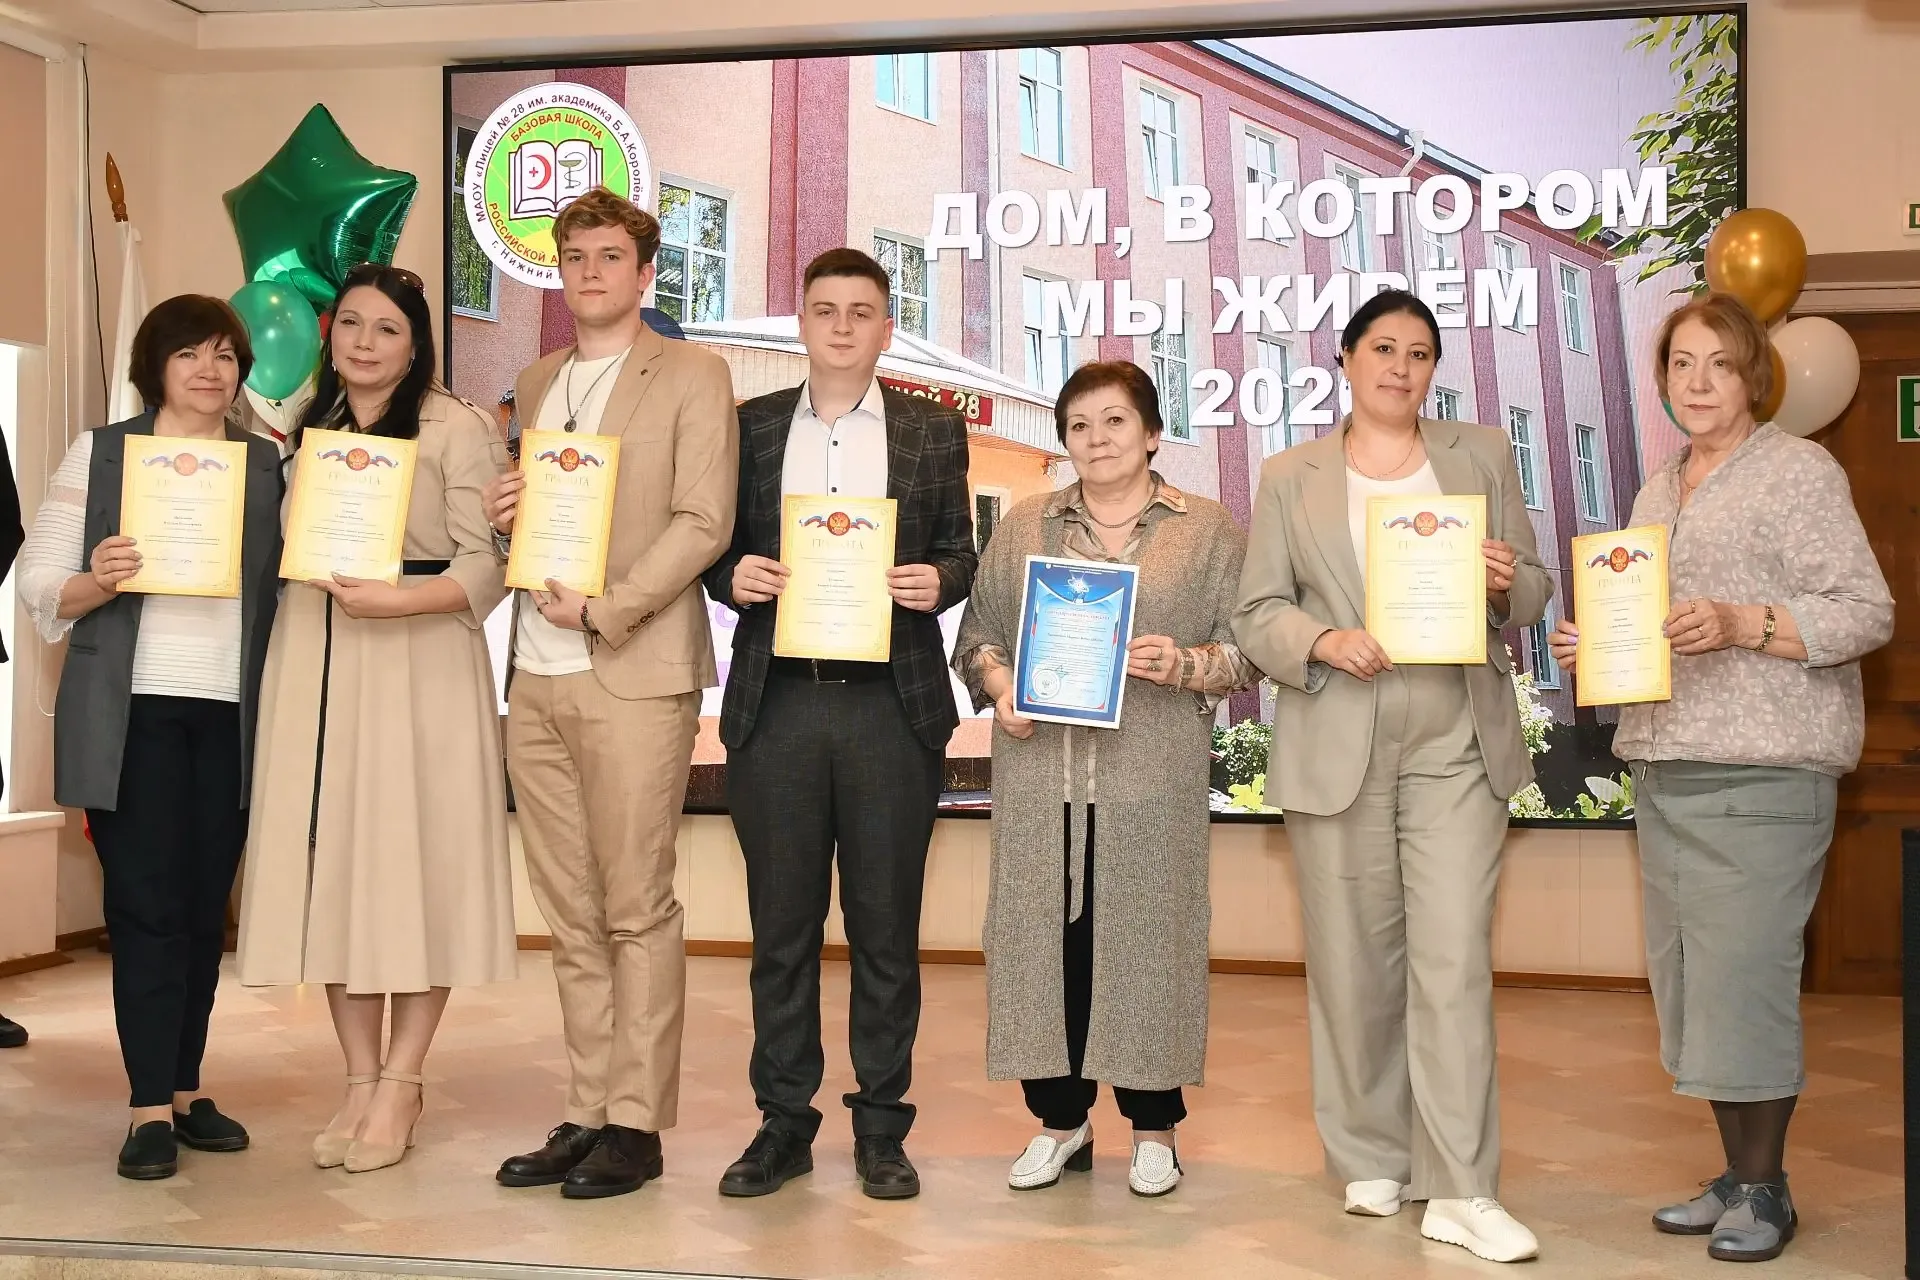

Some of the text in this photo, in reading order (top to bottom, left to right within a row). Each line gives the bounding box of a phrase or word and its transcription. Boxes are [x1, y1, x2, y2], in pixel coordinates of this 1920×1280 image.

[511, 103, 525, 118] 28
[527, 97, 547, 108] им.
[551, 94, 612, 122] академика
[497, 116, 510, 129] №
[510, 112, 604, 142] БАЗОВАЯ ШКОЛА
[475, 130, 499, 177] «Лицей
[473, 182, 486, 222] МАОУ
[923, 166, 1669, 261] ДОМ, В КОТОРОМ
[489, 202, 546, 263] РОССИЙСКОЙ
[491, 240, 553, 279] г. Нижний
[1046, 277, 1184, 337] МЫ
[545, 473, 590, 487] ГРАОТА
[812, 538, 864, 550] ГРАОТА
